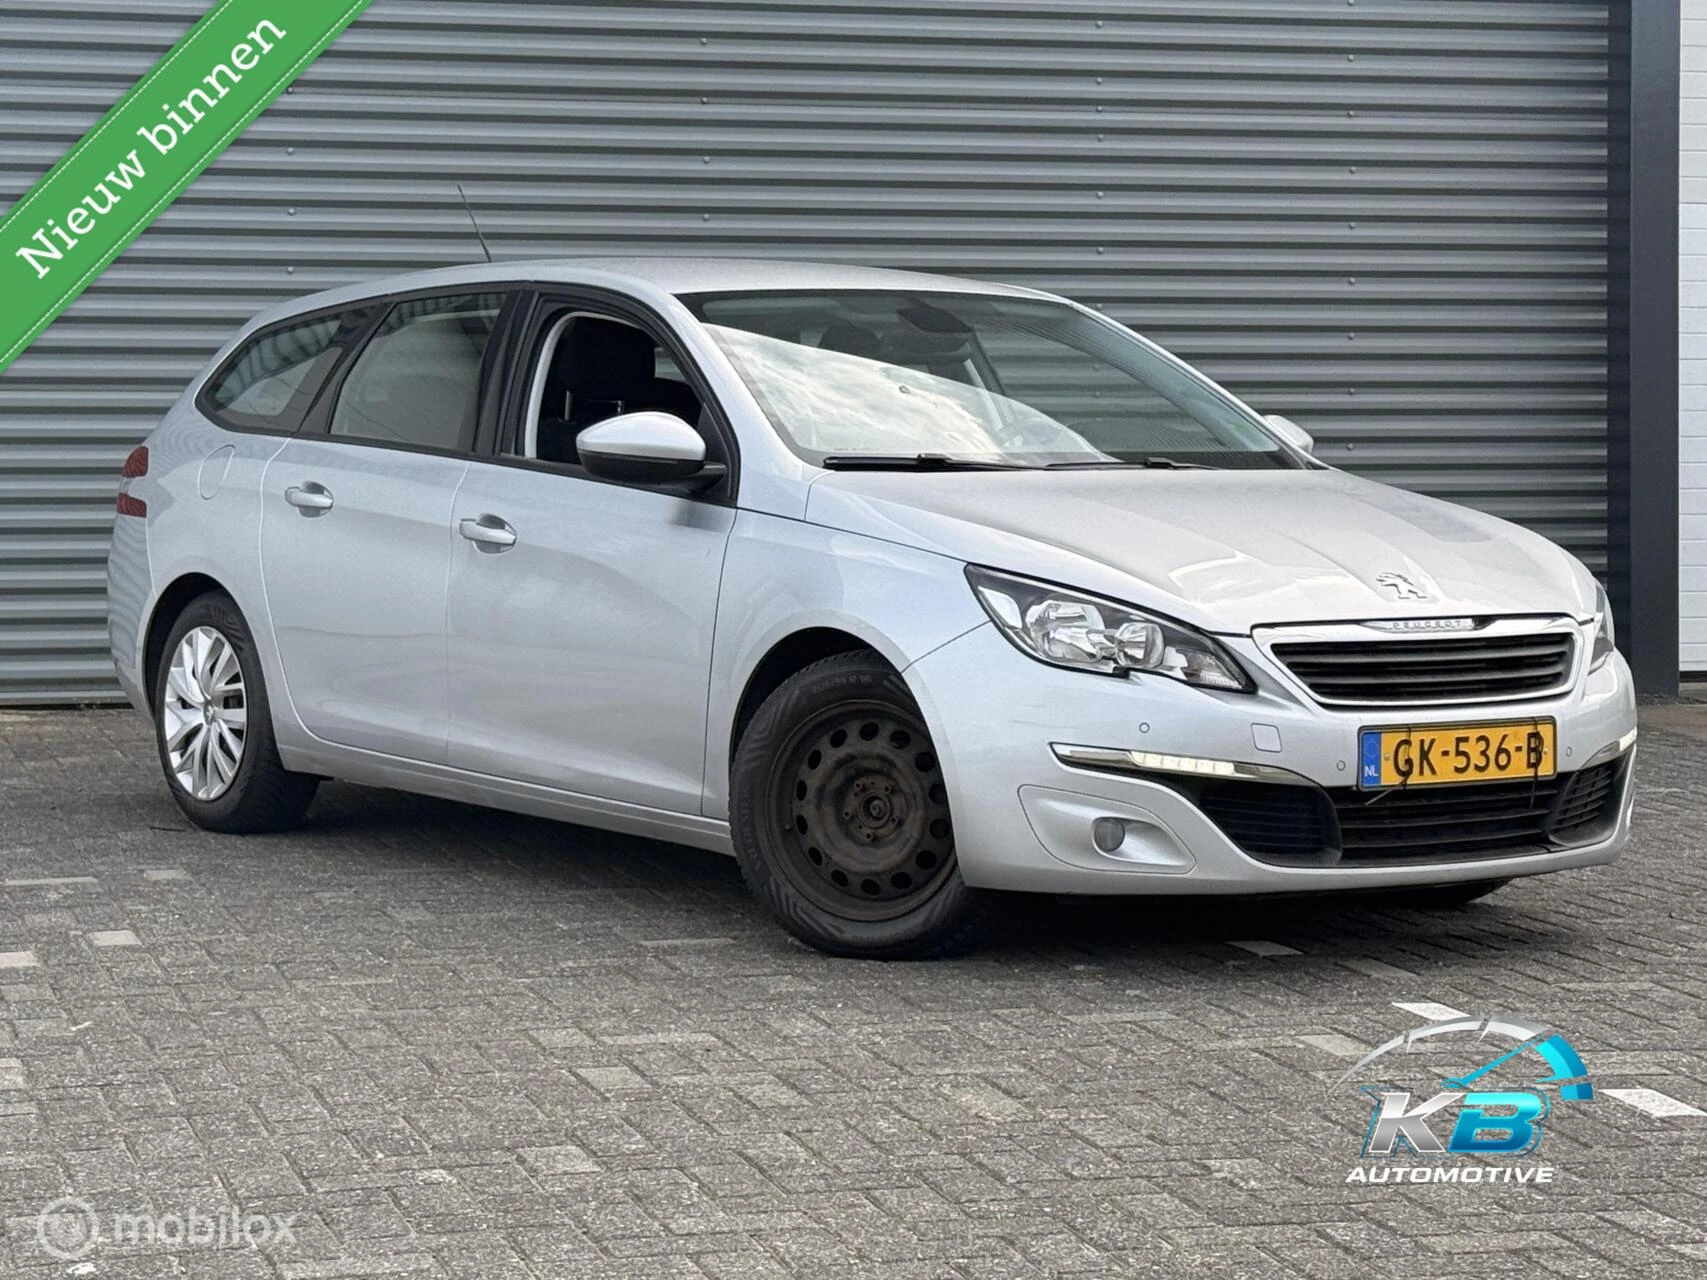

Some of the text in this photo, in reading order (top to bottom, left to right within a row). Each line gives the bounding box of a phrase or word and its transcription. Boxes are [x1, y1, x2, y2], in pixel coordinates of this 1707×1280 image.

[1392, 619, 1462, 630] PEUGEOT
[1393, 731, 1544, 777] GK-536-B
[1364, 765, 1379, 777] NL
